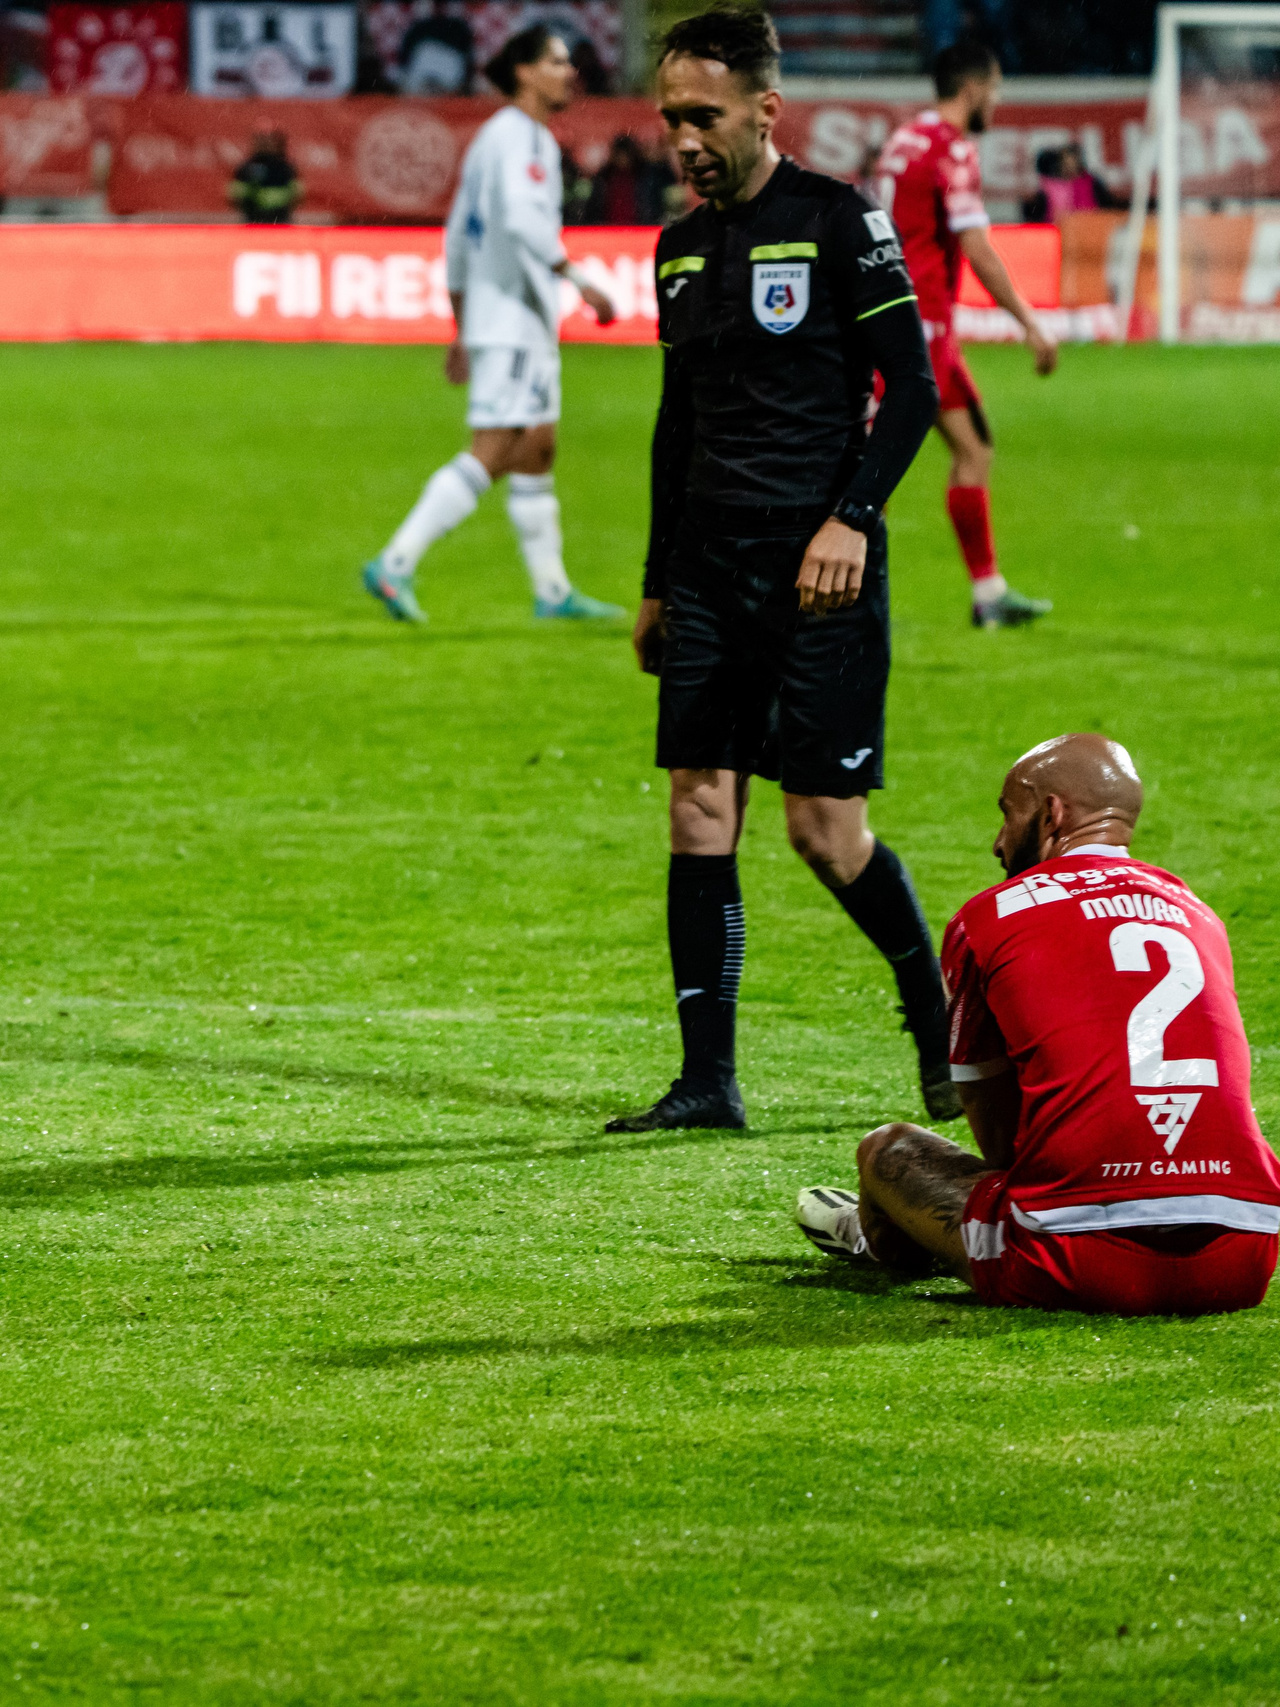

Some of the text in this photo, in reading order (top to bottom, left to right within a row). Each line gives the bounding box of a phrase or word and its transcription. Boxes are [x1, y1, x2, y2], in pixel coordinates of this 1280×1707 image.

[233, 251, 321, 318] FII
[1080, 893, 1191, 928] MOURA
[1108, 922, 1219, 1087] 2
[1101, 1160, 1232, 1177] 7777 GAMING
